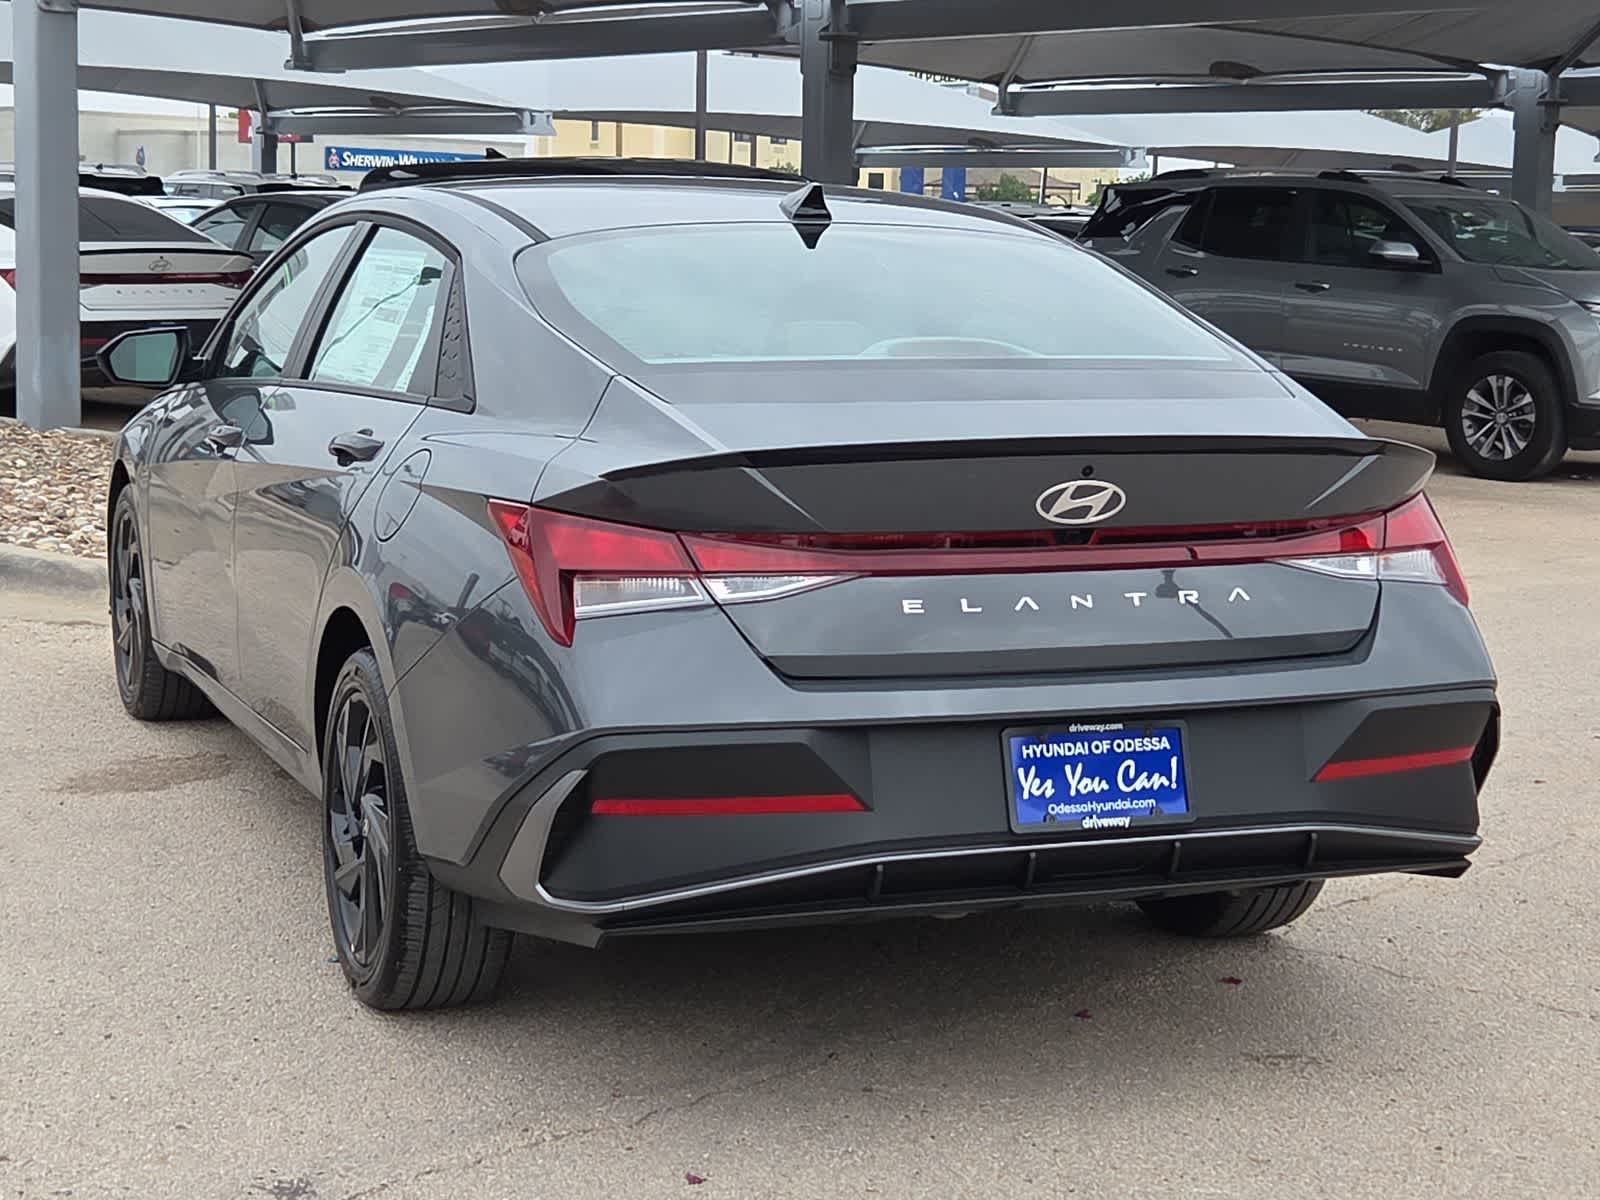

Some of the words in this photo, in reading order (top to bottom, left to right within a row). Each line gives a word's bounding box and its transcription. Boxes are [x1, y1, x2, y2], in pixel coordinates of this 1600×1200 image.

[902, 587, 1250, 614] ELANTRA
[1068, 722, 1124, 733] driveway.com
[1022, 742, 1089, 759] HYUNDAI
[1091, 740, 1111, 754] OF
[1113, 736, 1171, 752] ODESSA
[1017, 765, 1055, 800] Yes
[1064, 762, 1109, 797] You
[1117, 756, 1178, 793] Can!
[1048, 798, 1156, 815] OdessaHyundai.com
[1082, 815, 1131, 829] driveway
